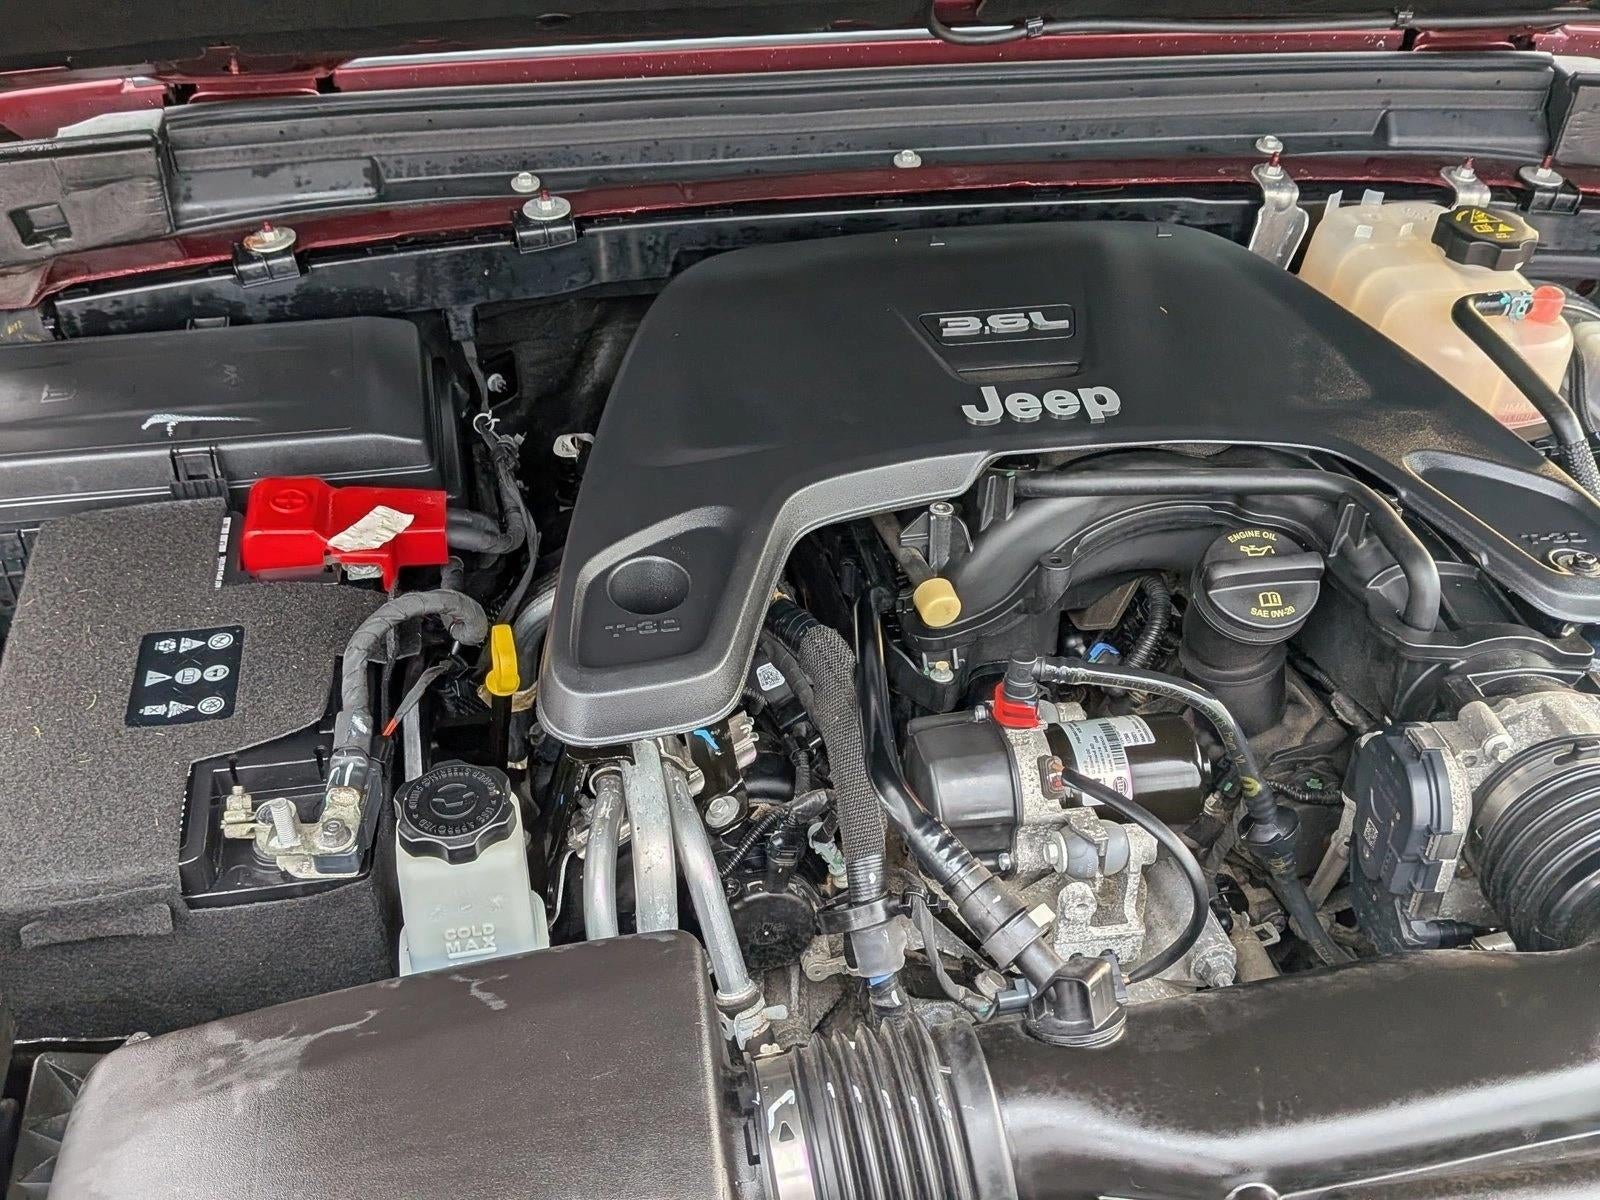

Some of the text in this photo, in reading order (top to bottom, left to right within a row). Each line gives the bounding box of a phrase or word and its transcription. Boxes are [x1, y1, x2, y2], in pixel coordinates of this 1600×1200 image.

[939, 311, 1070, 337] 3.6L
[961, 386, 1121, 426] Jeep
[1227, 530, 1277, 543] ENGINE OIL
[1250, 607, 1270, 618] SAE
[444, 923, 495, 940] COLD
[445, 935, 496, 954] MAX
